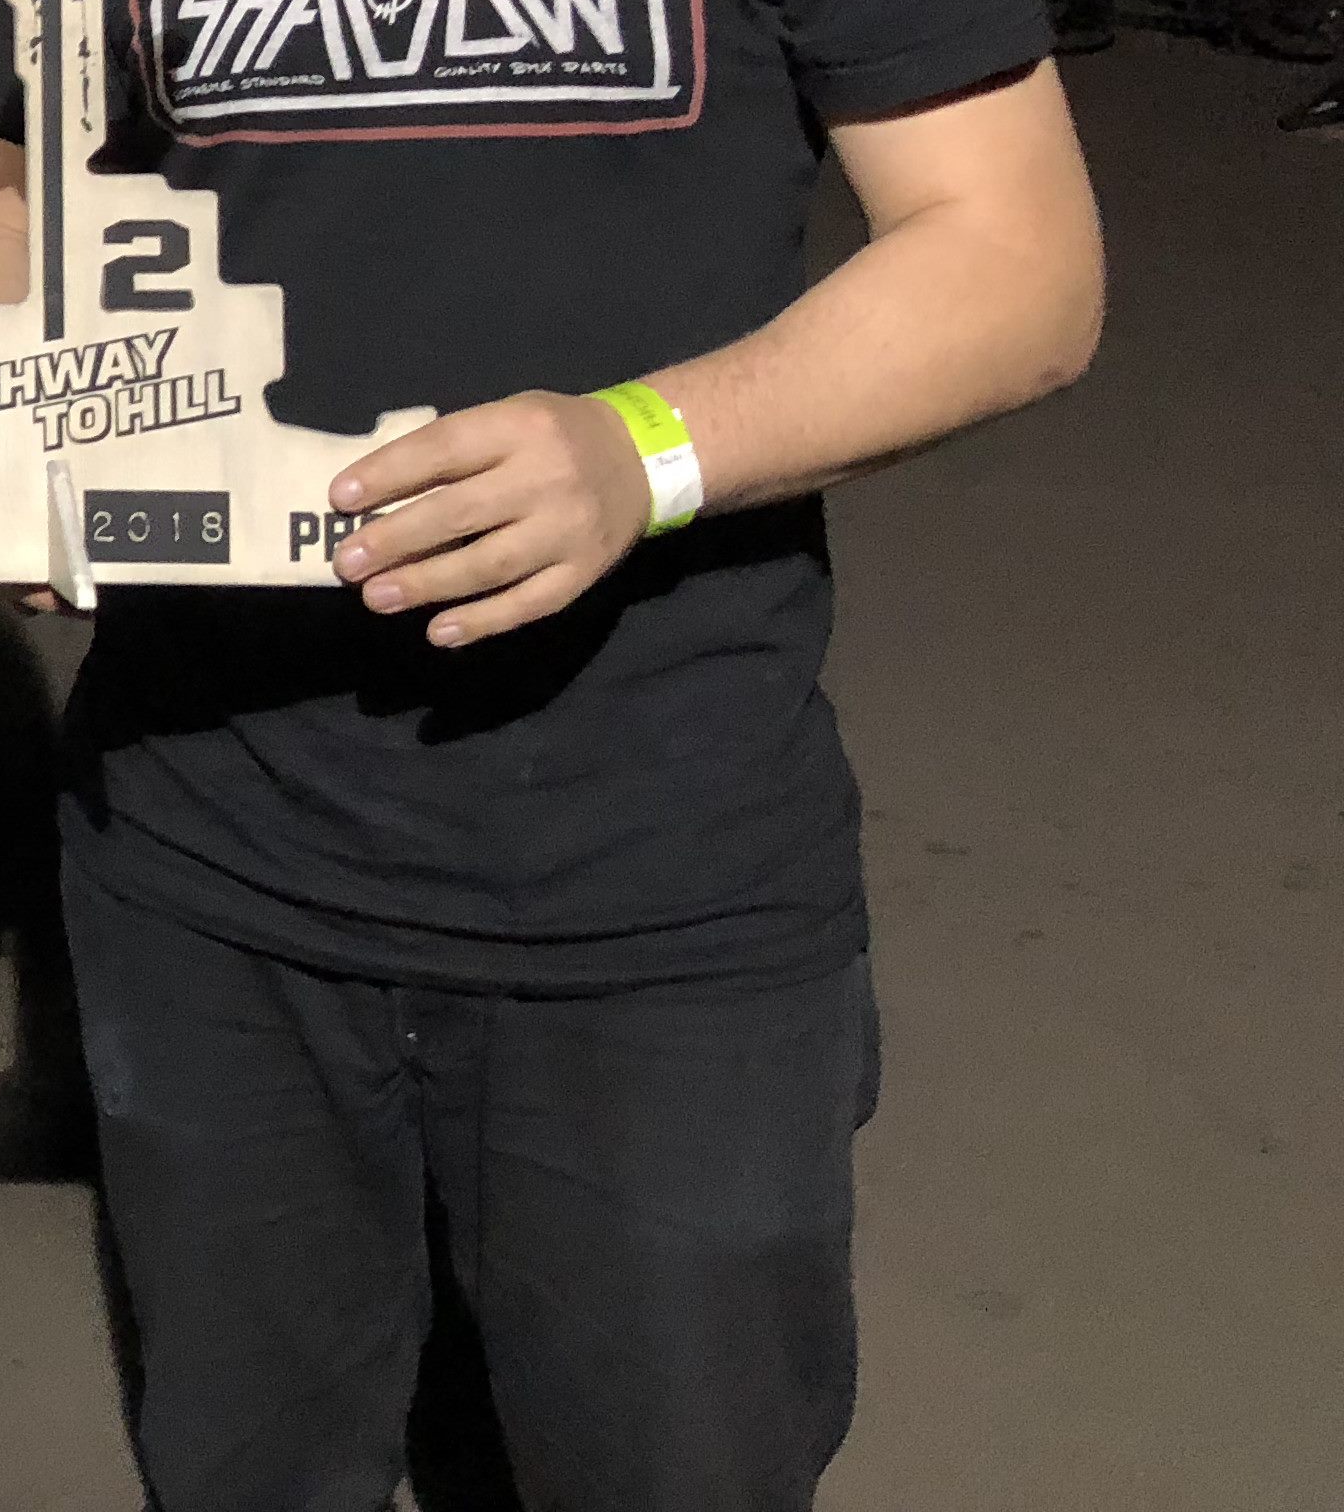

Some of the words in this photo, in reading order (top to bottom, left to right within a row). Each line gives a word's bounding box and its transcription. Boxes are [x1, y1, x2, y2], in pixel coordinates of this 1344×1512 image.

[100, 219, 194, 312] 2
[33, 393, 113, 453] TO
[114, 368, 242, 438] HILL
[92, 510, 224, 544] 2018
[289, 510, 388, 563] PR
